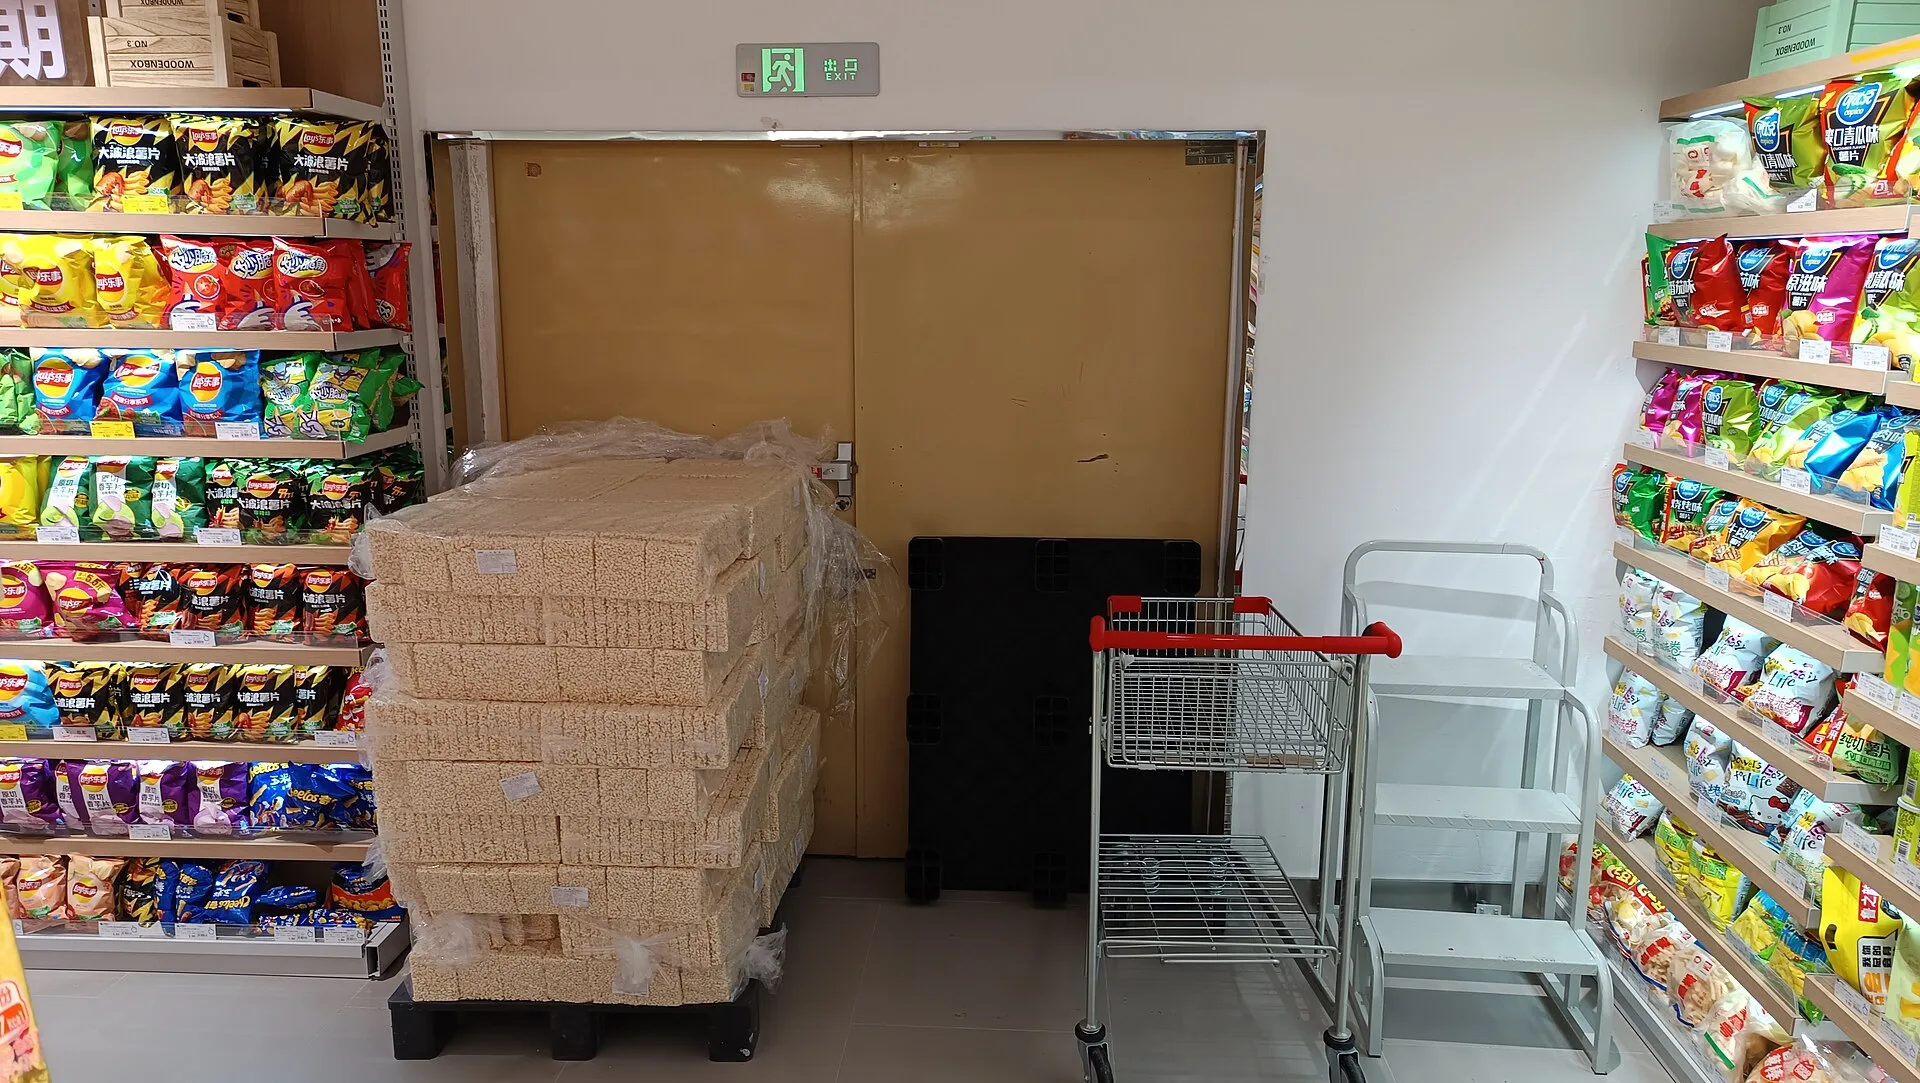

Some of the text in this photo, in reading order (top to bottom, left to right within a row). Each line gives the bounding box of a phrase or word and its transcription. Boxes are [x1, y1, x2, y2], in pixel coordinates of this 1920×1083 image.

[1778, 24, 1792, 35] NO.3
[126, 40, 148, 48] NO.3
[1774, 37, 1816, 57] WOODENBOX
[130, 60, 194, 68] WOODENBOX
[824, 58, 858, 72] 出口
[826, 72, 856, 81] EXIT
[1825, 124, 1880, 146] 爽口青瓜味
[99, 146, 160, 161] 大波浪薯片
[183, 153, 236, 167] 大波浪薯片
[1838, 150, 1860, 162] 薯片
[294, 154, 349, 171] 大波浪薯片
[234, 252, 273, 279] 妙脆
[1786, 274, 1828, 293] 原滋味
[206, 487, 238, 499] 大波浪薯
[191, 595, 229, 606] 波浪薯片
[250, 588, 284, 600] 波浪薯片
[1768, 670, 1796, 688] Life
[130, 692, 170, 703] 波浪薯片
[185, 692, 221, 703] 波浪薯片
[1838, 732, 1892, 761] 纯切薯片
[1733, 770, 1747, 781] for
[1761, 763, 1788, 781] Easy
[1746, 771, 1773, 789] Life
